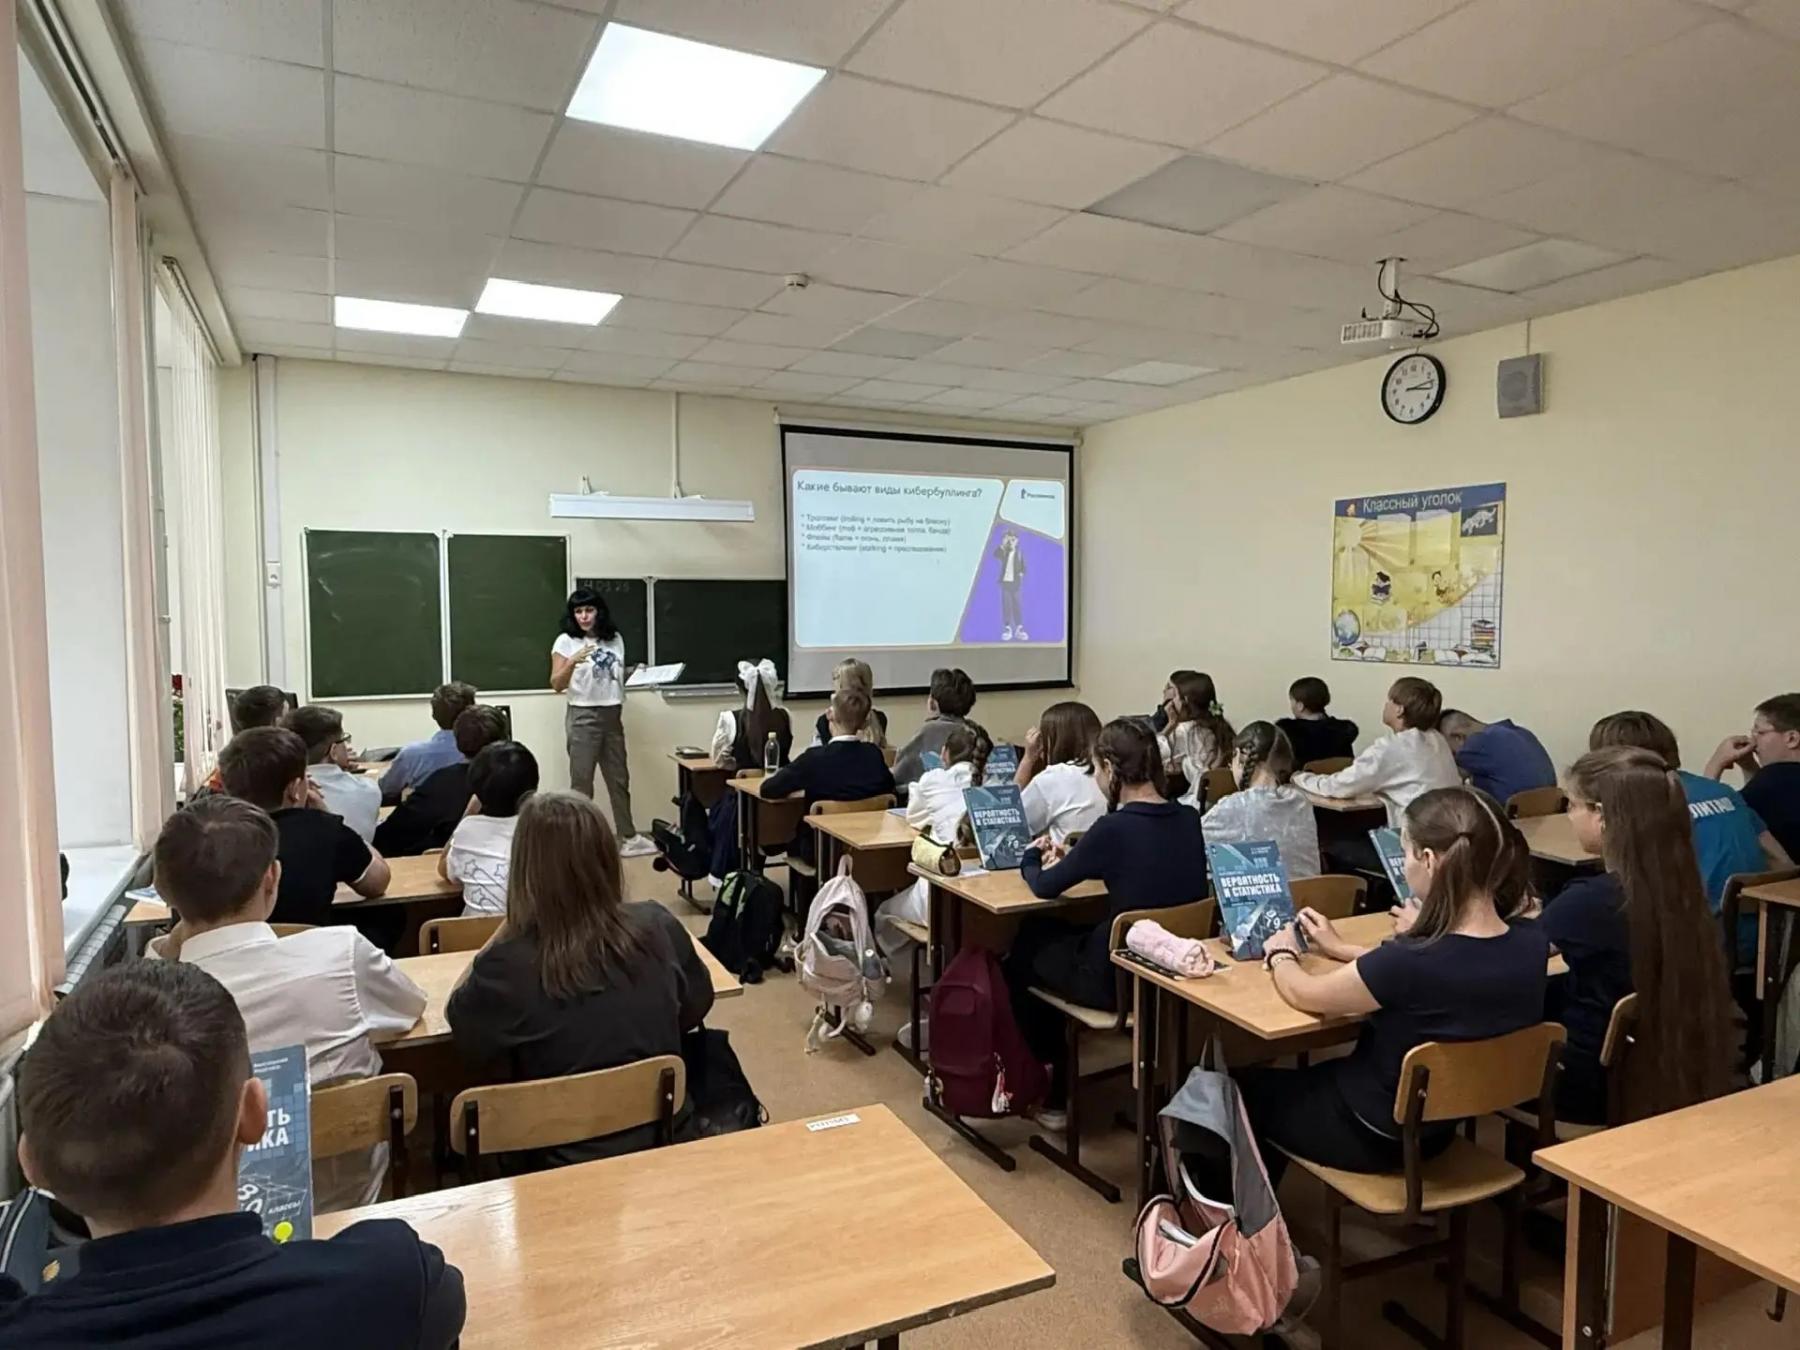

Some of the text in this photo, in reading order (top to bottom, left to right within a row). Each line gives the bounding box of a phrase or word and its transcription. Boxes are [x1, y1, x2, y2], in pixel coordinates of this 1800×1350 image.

[797, 480, 983, 499] Какие бывают виды кибербуллинга?
[1363, 491, 1463, 513] Классный уголок
[1220, 873, 1281, 888] ВЕРОЯТНОСТЬ
[1223, 883, 1283, 898] И СТАТИСТИКА
